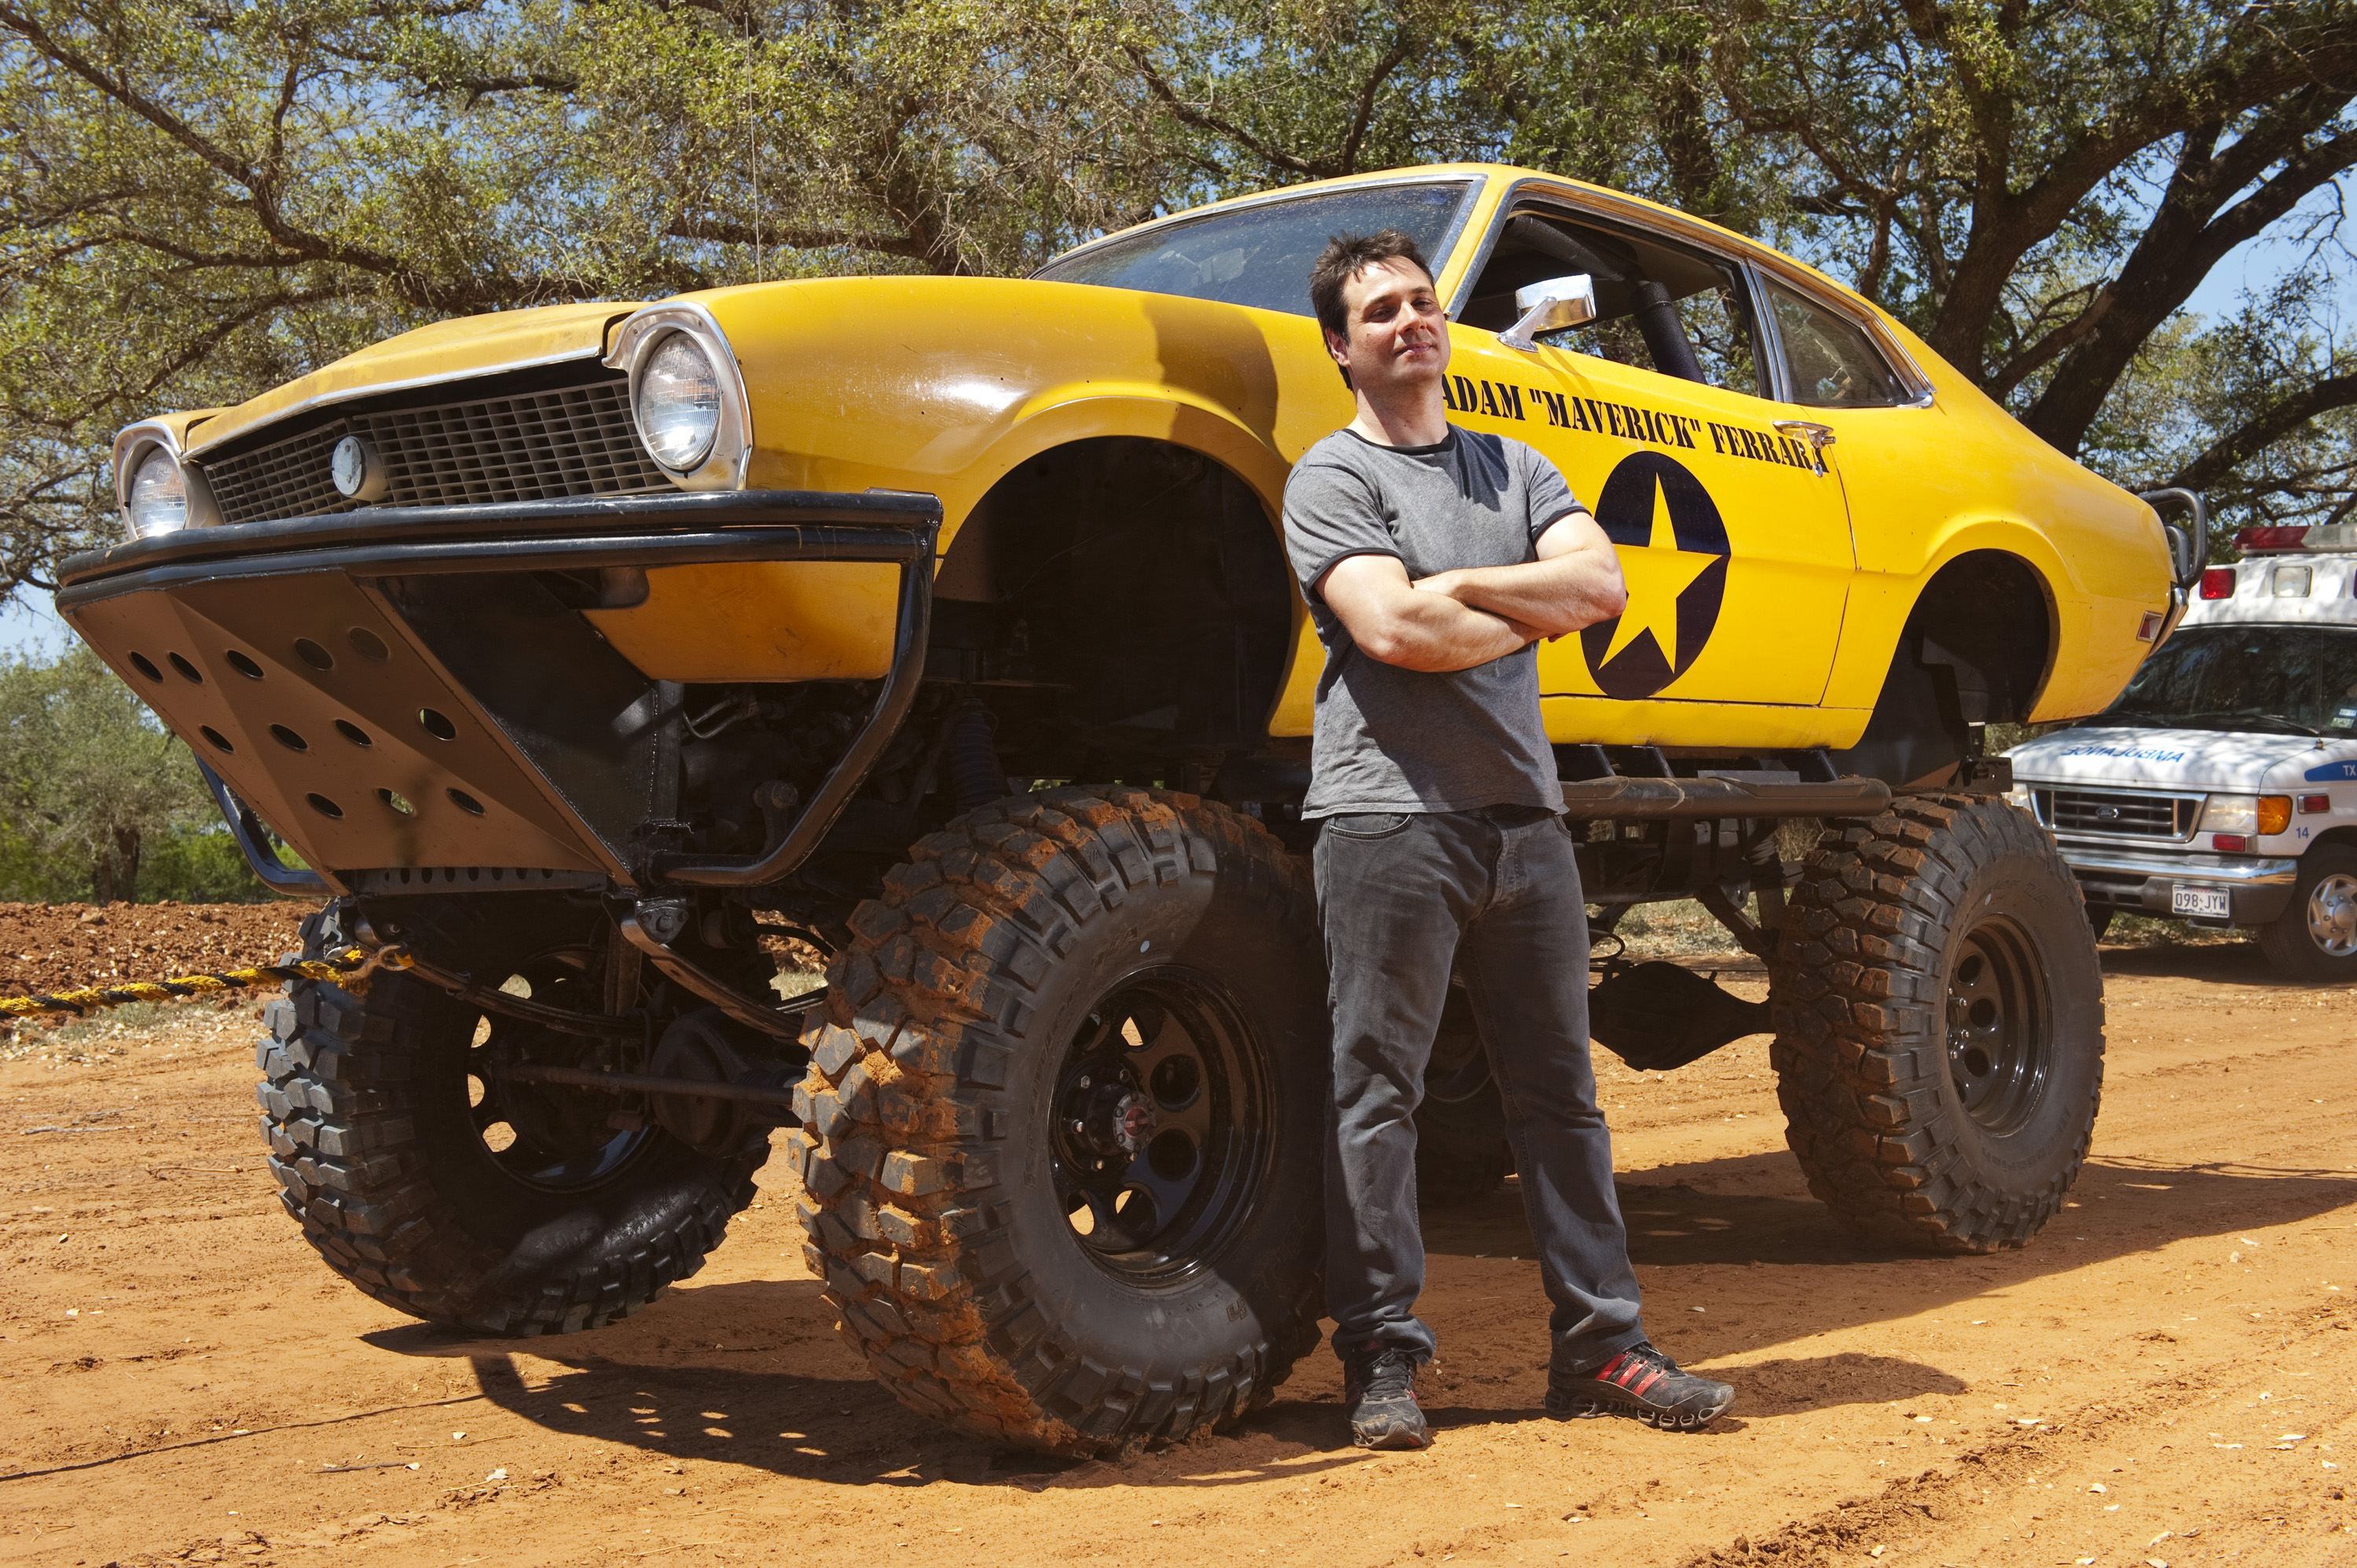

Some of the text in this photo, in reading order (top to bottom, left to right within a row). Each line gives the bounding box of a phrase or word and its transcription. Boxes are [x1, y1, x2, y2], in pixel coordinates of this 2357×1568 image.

[1442, 373, 1526, 421] ADAM
[1529, 388, 1701, 449] "MAVERICK"
[2342, 764, 2357, 776] TX
[2296, 827, 2309, 839] 14
